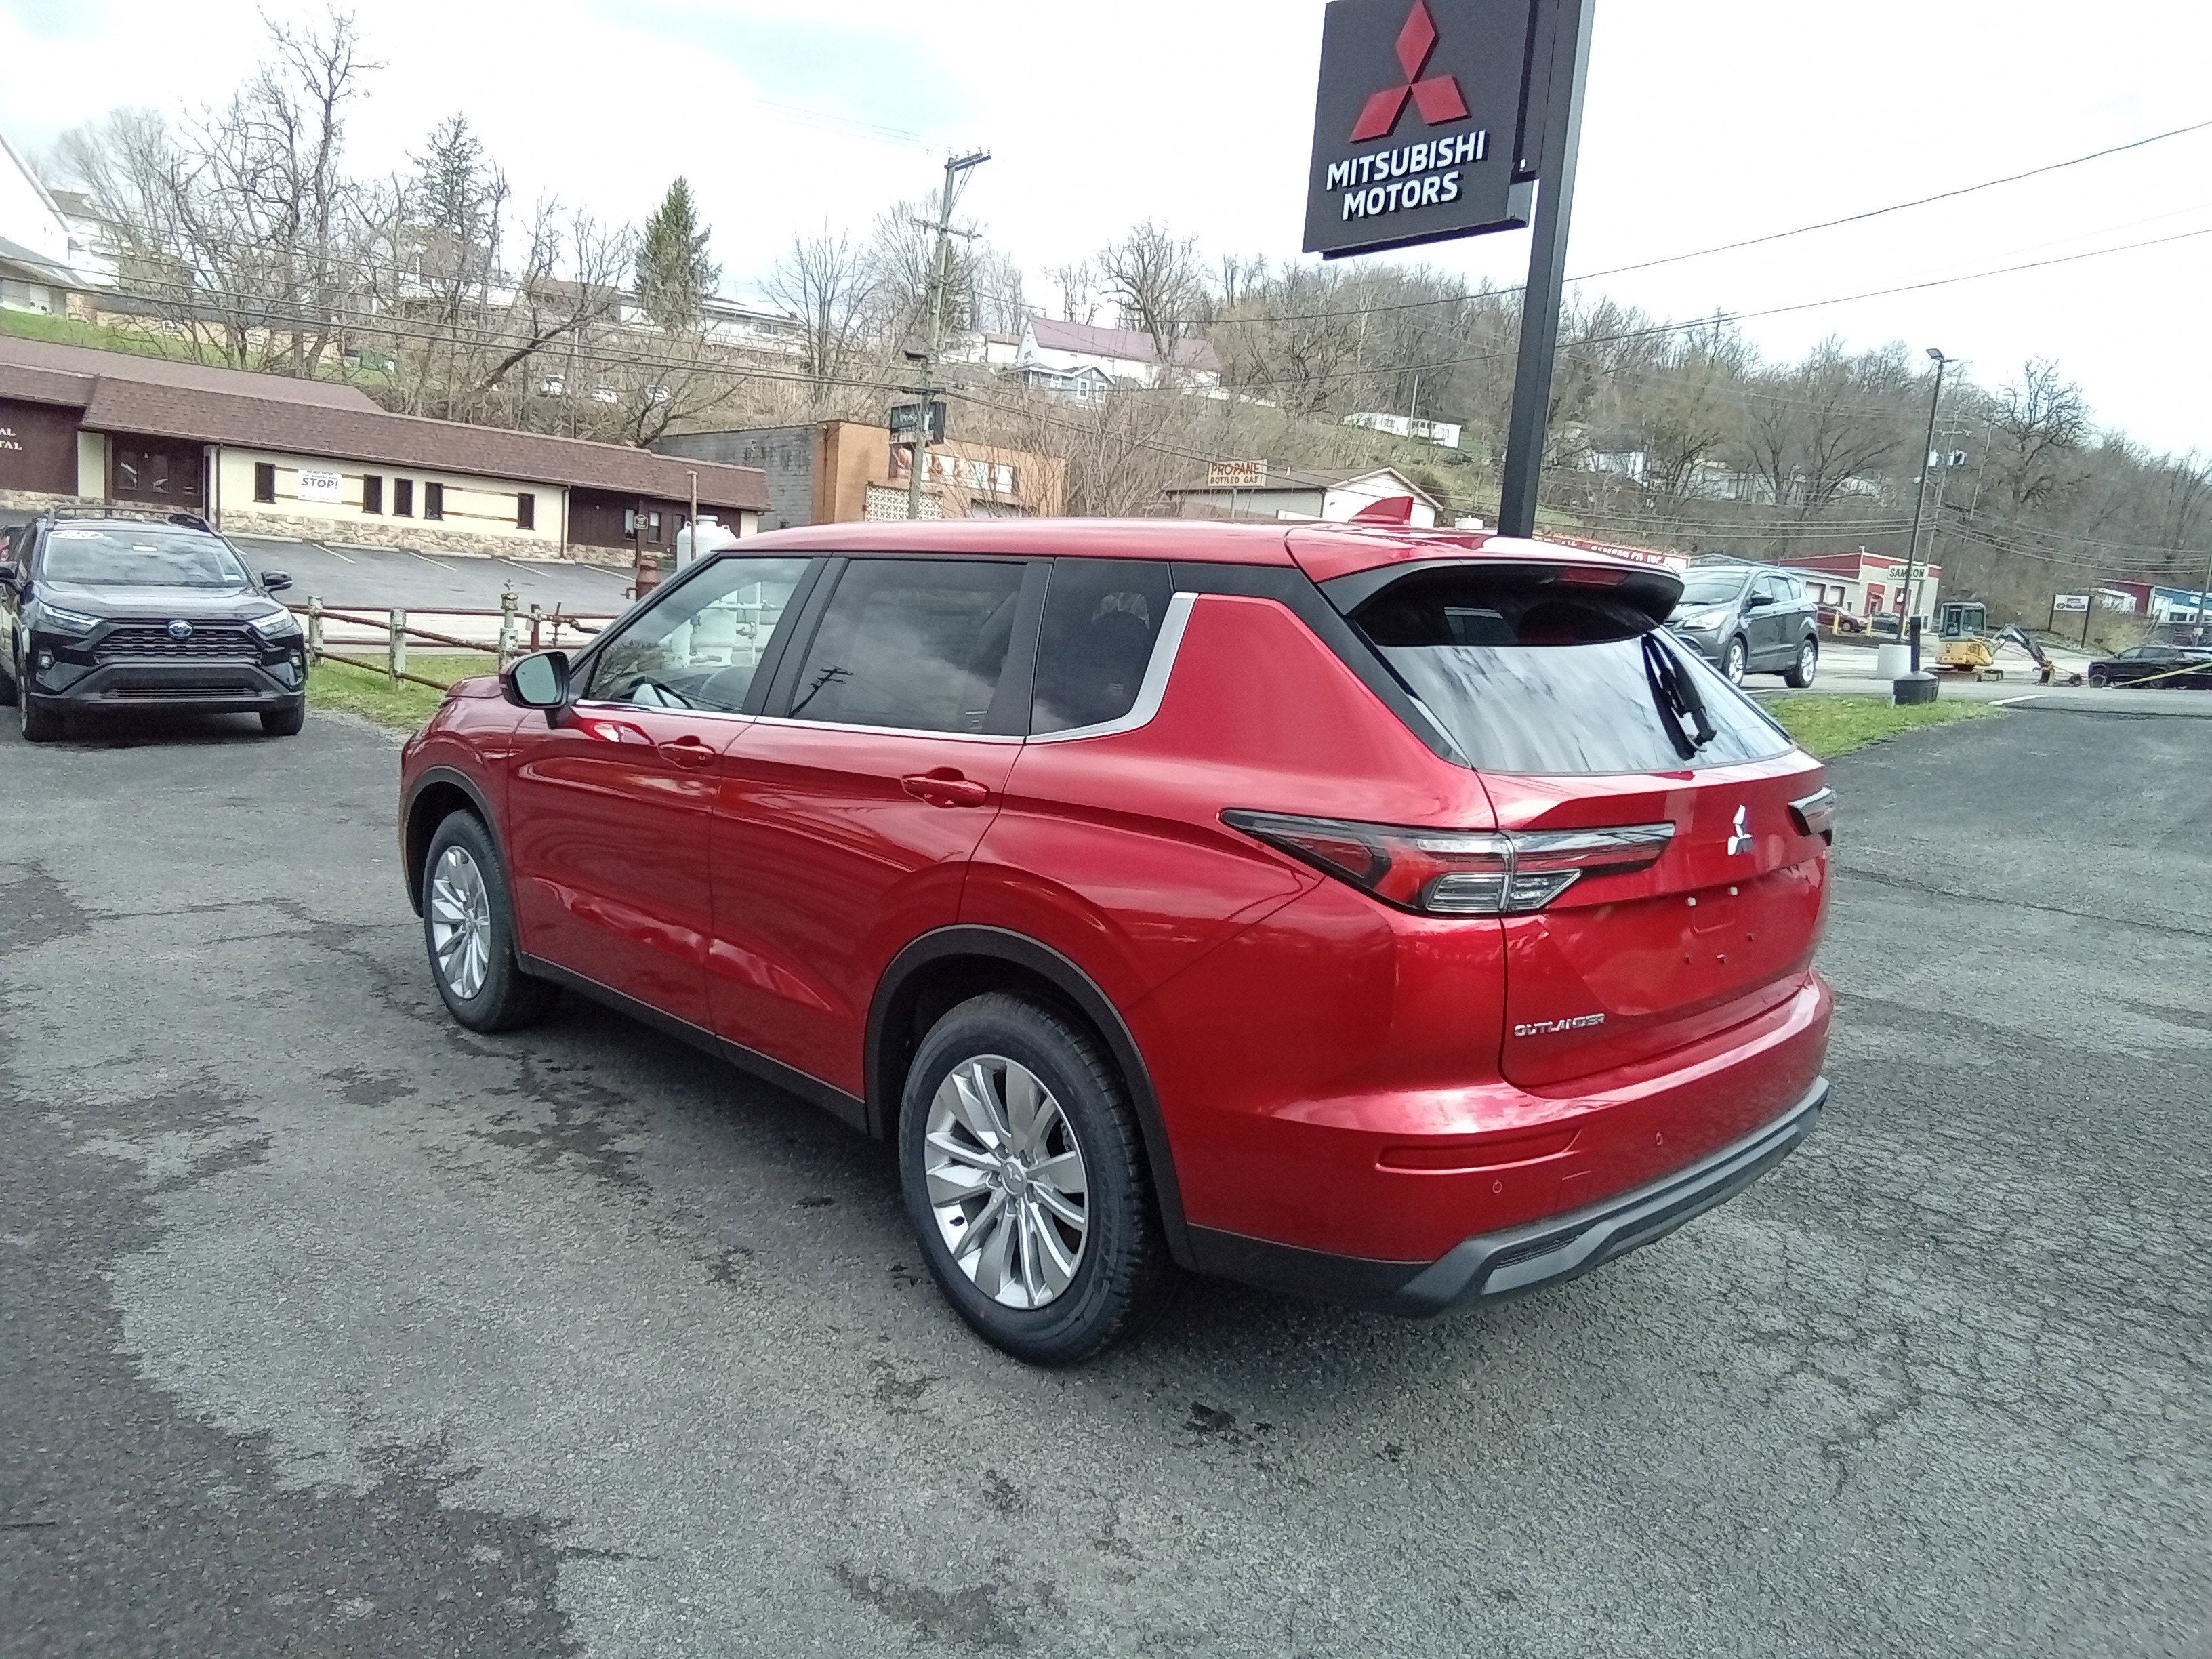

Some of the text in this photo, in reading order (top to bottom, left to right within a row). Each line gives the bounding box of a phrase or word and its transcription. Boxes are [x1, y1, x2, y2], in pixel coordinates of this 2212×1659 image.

[1326, 130, 1486, 191] MITSUBISHI
[1342, 171, 1459, 220] MOTORS
[1211, 462, 1259, 476] PROPANE
[302, 477, 339, 489] STOP!
[1889, 568, 1925, 577] SAMON
[1514, 1012, 1605, 1037] OUTLANDER
